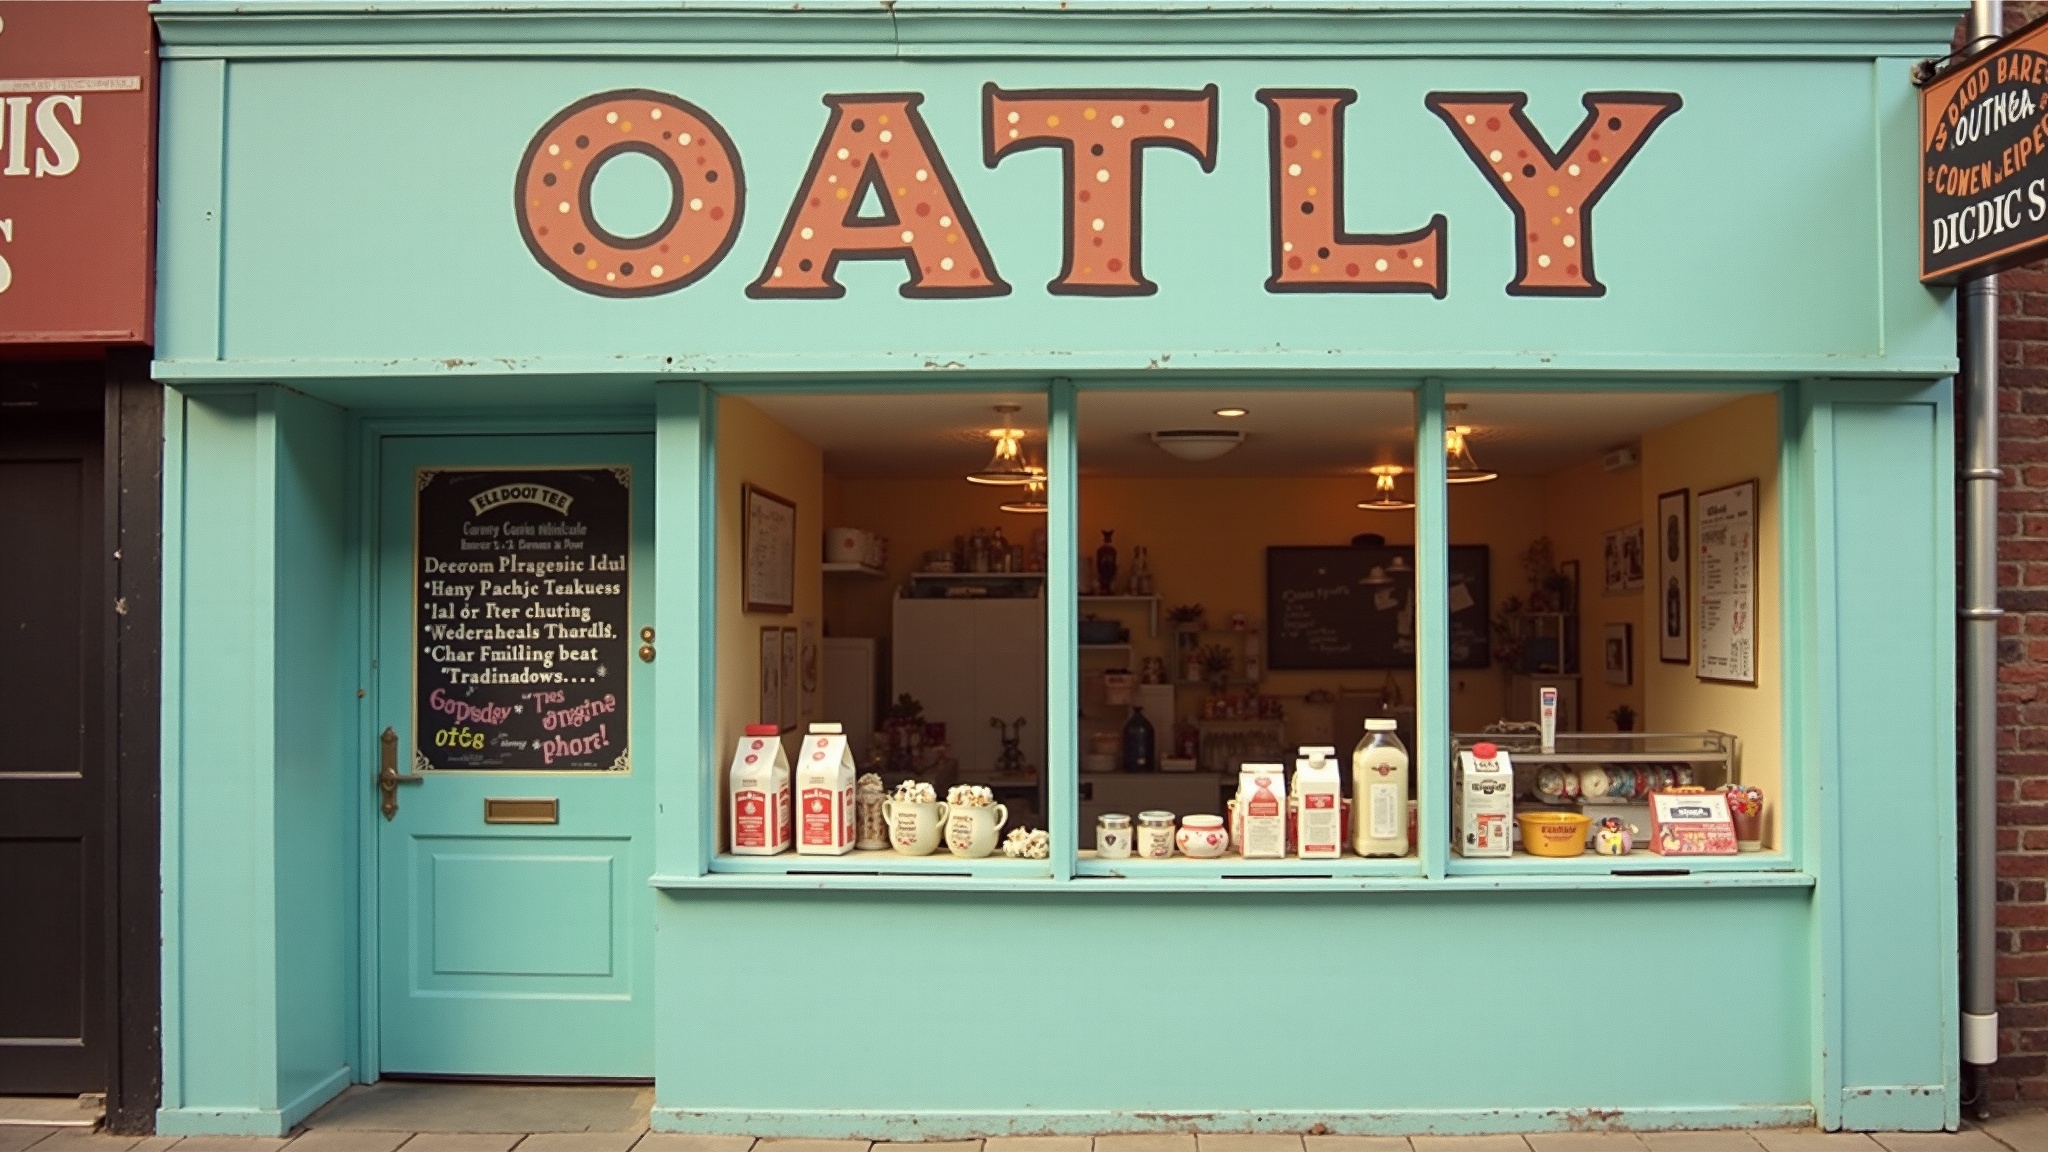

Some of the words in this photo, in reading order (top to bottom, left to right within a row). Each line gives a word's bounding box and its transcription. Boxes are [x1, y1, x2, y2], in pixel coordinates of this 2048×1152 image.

[0, 94, 83, 178] IS
[514, 82, 1683, 300] OATLY
[558, 643, 600, 662] beat
